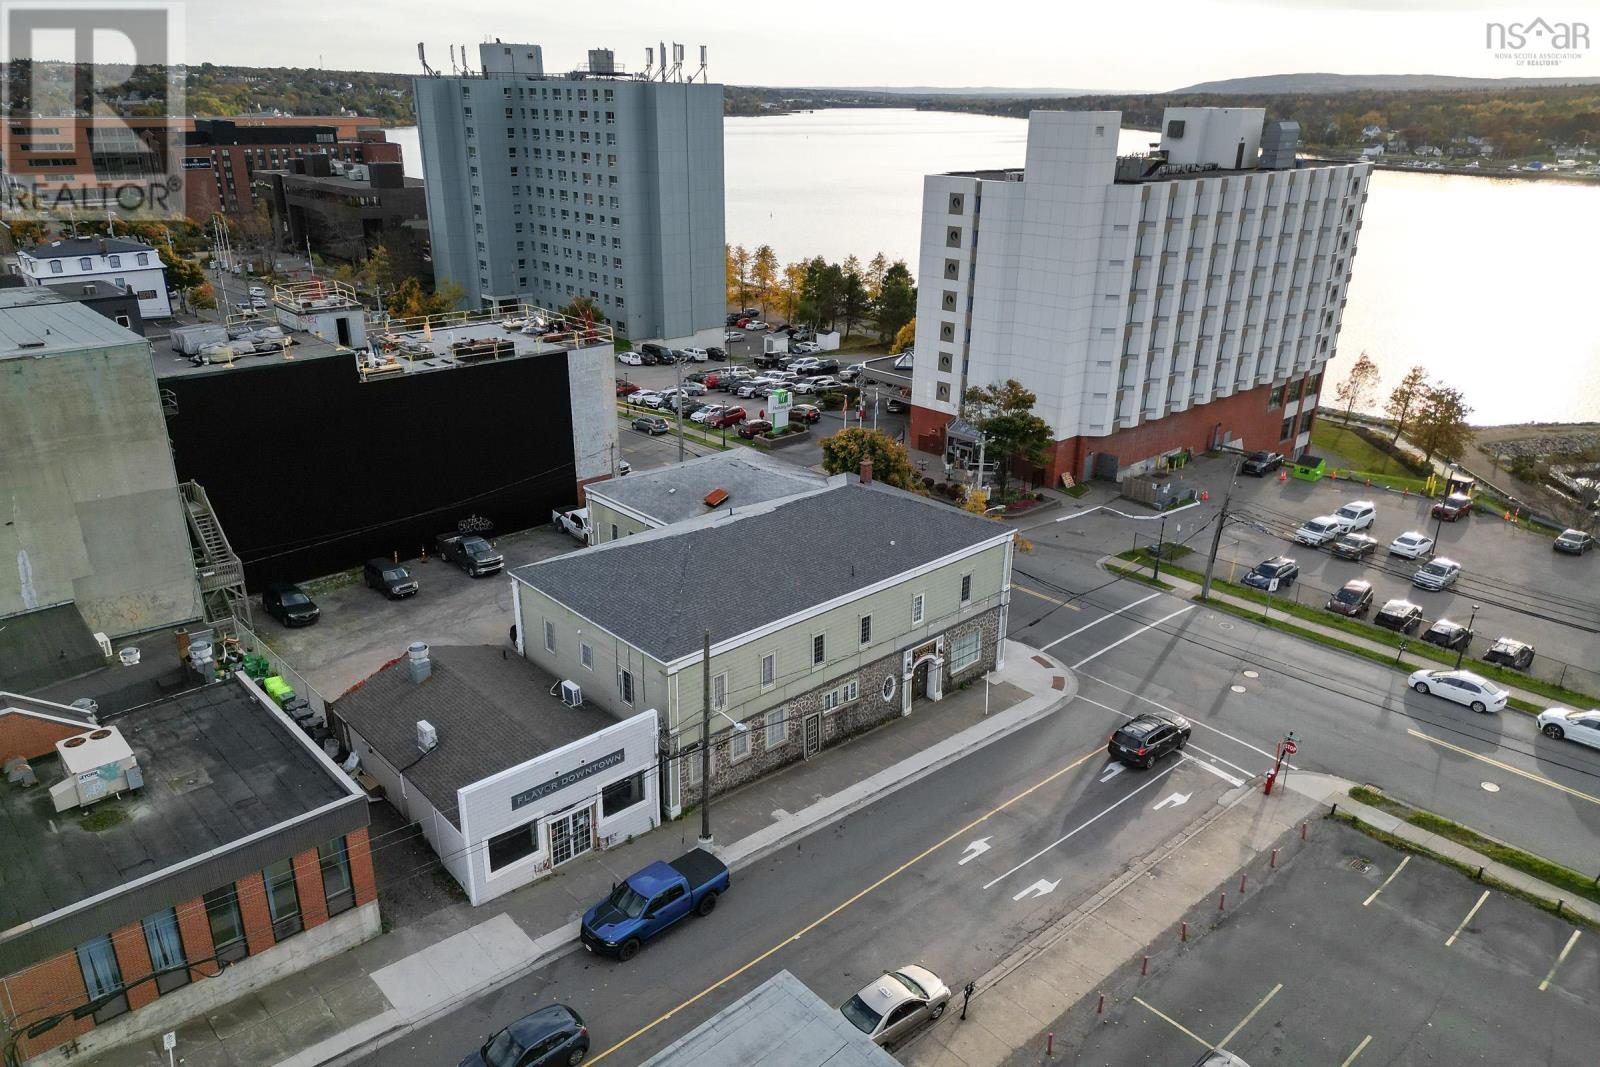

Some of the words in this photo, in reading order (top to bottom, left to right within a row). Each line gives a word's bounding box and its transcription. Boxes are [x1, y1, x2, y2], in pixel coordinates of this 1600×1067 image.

[1285, 744, 1297, 752] STOP
[517, 781, 558, 806] FLAVOR
[561, 753, 622, 786] DOWNTOWN
